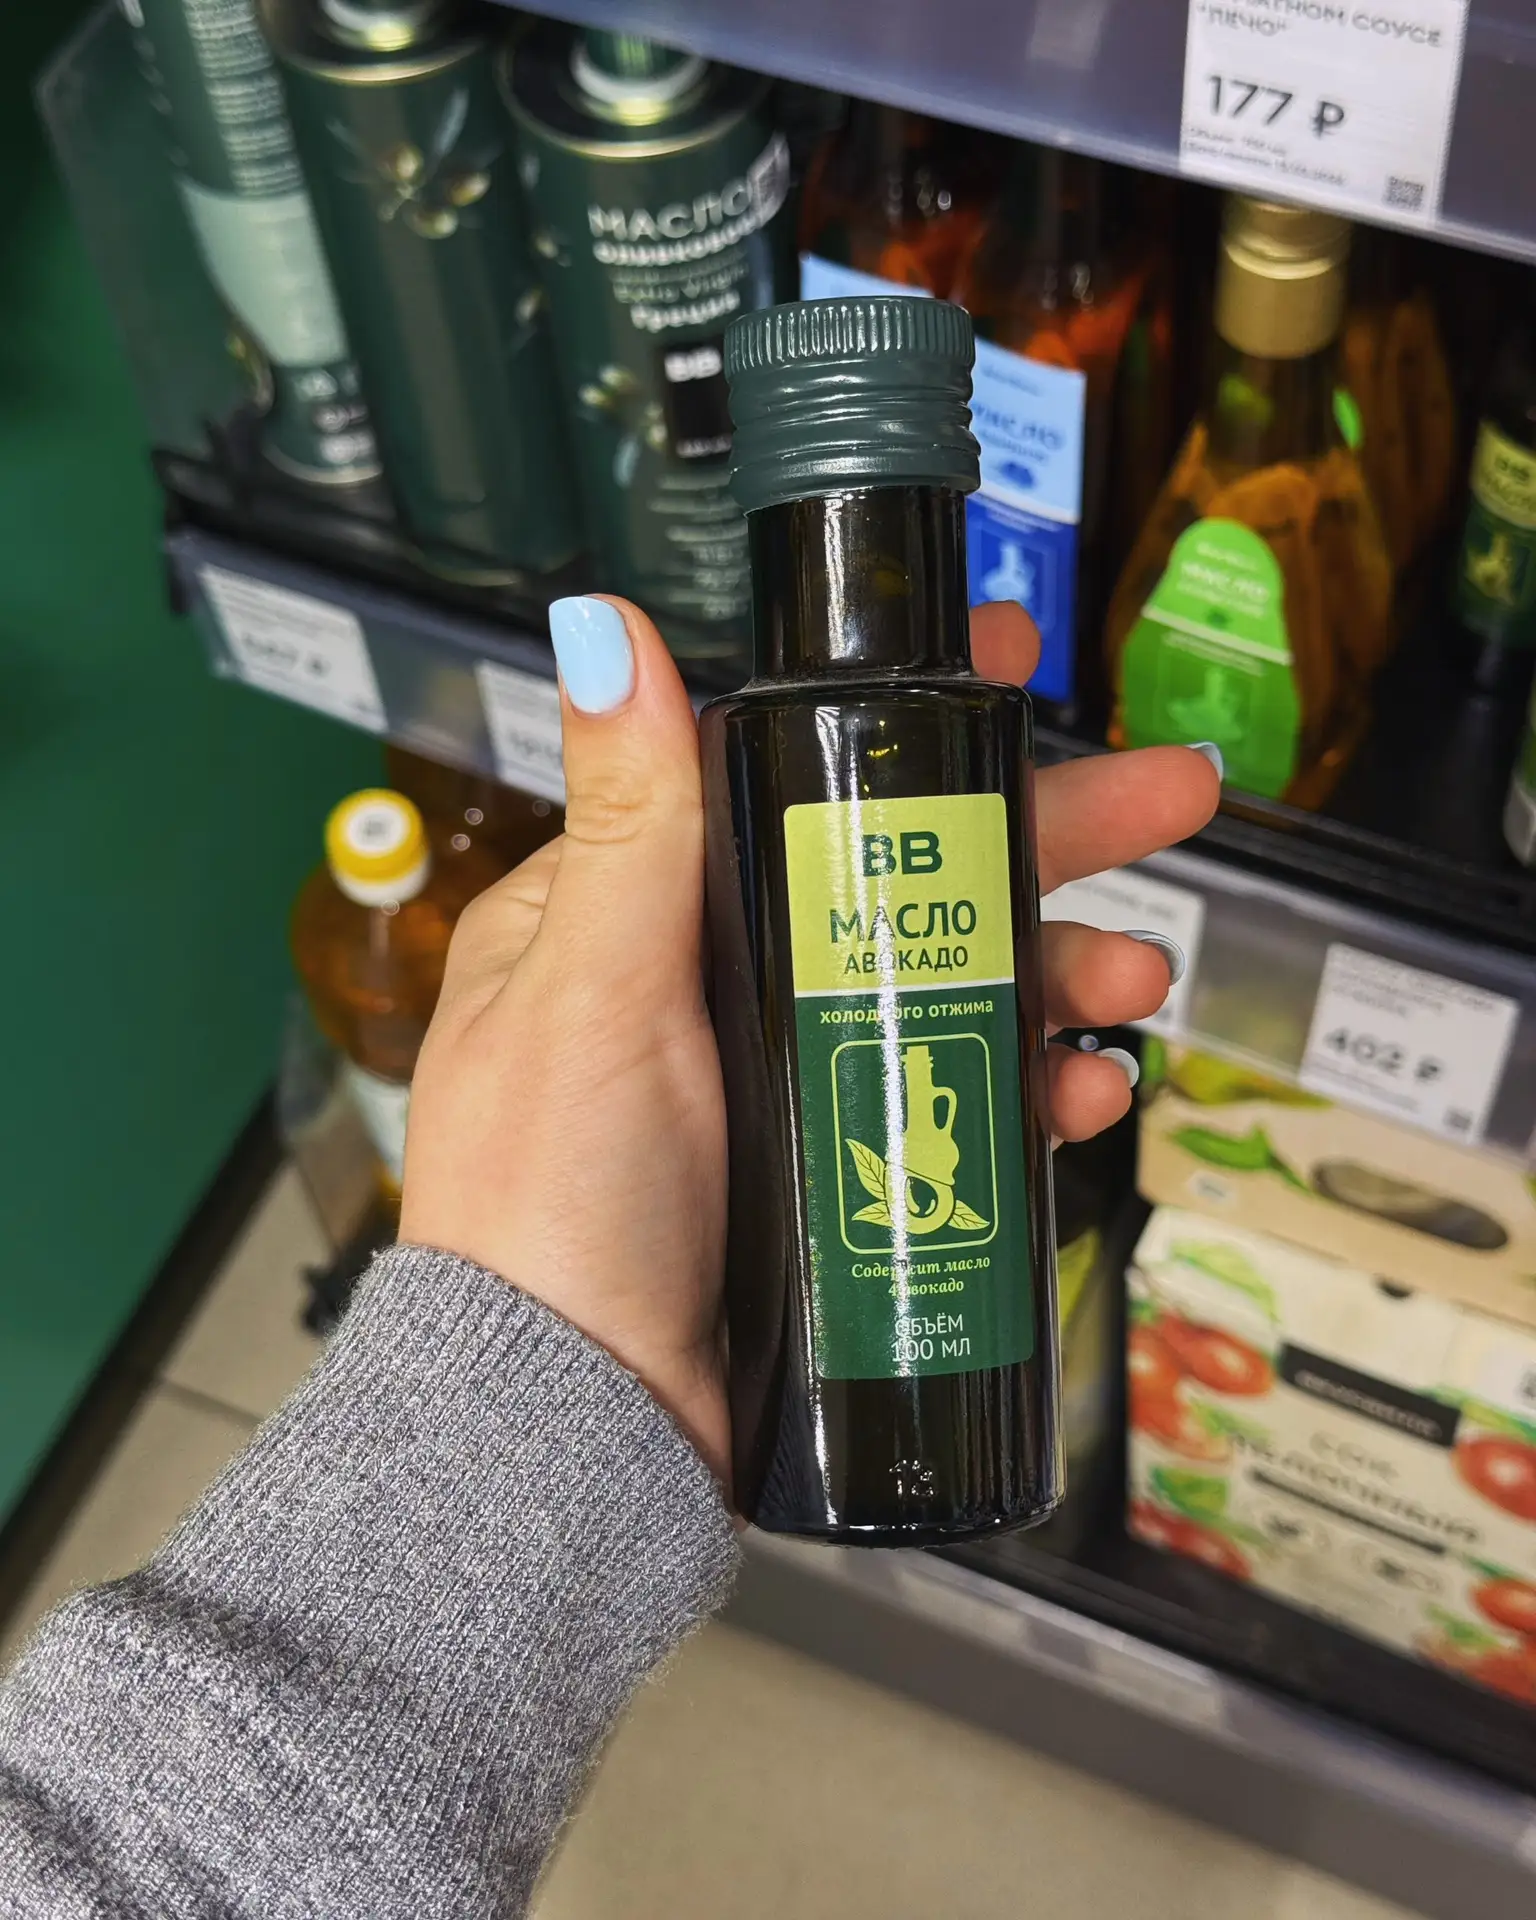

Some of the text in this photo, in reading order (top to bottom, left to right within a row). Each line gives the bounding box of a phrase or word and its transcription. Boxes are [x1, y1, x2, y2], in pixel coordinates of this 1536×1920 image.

[1352, 12, 1442, 47] СОУСЕ
[1208, 75, 1294, 126] 177
[829, 900, 977, 943] МАСЛО
[844, 946, 969, 975] АВОКАДО
[819, 1000, 994, 1025] холодого отжима
[944, 1256, 991, 1273] масло
[901, 1278, 964, 1296] вокадо
[895, 1313, 963, 1338] ОБЪЁМ
[891, 1338, 971, 1362] 100 МЛ
